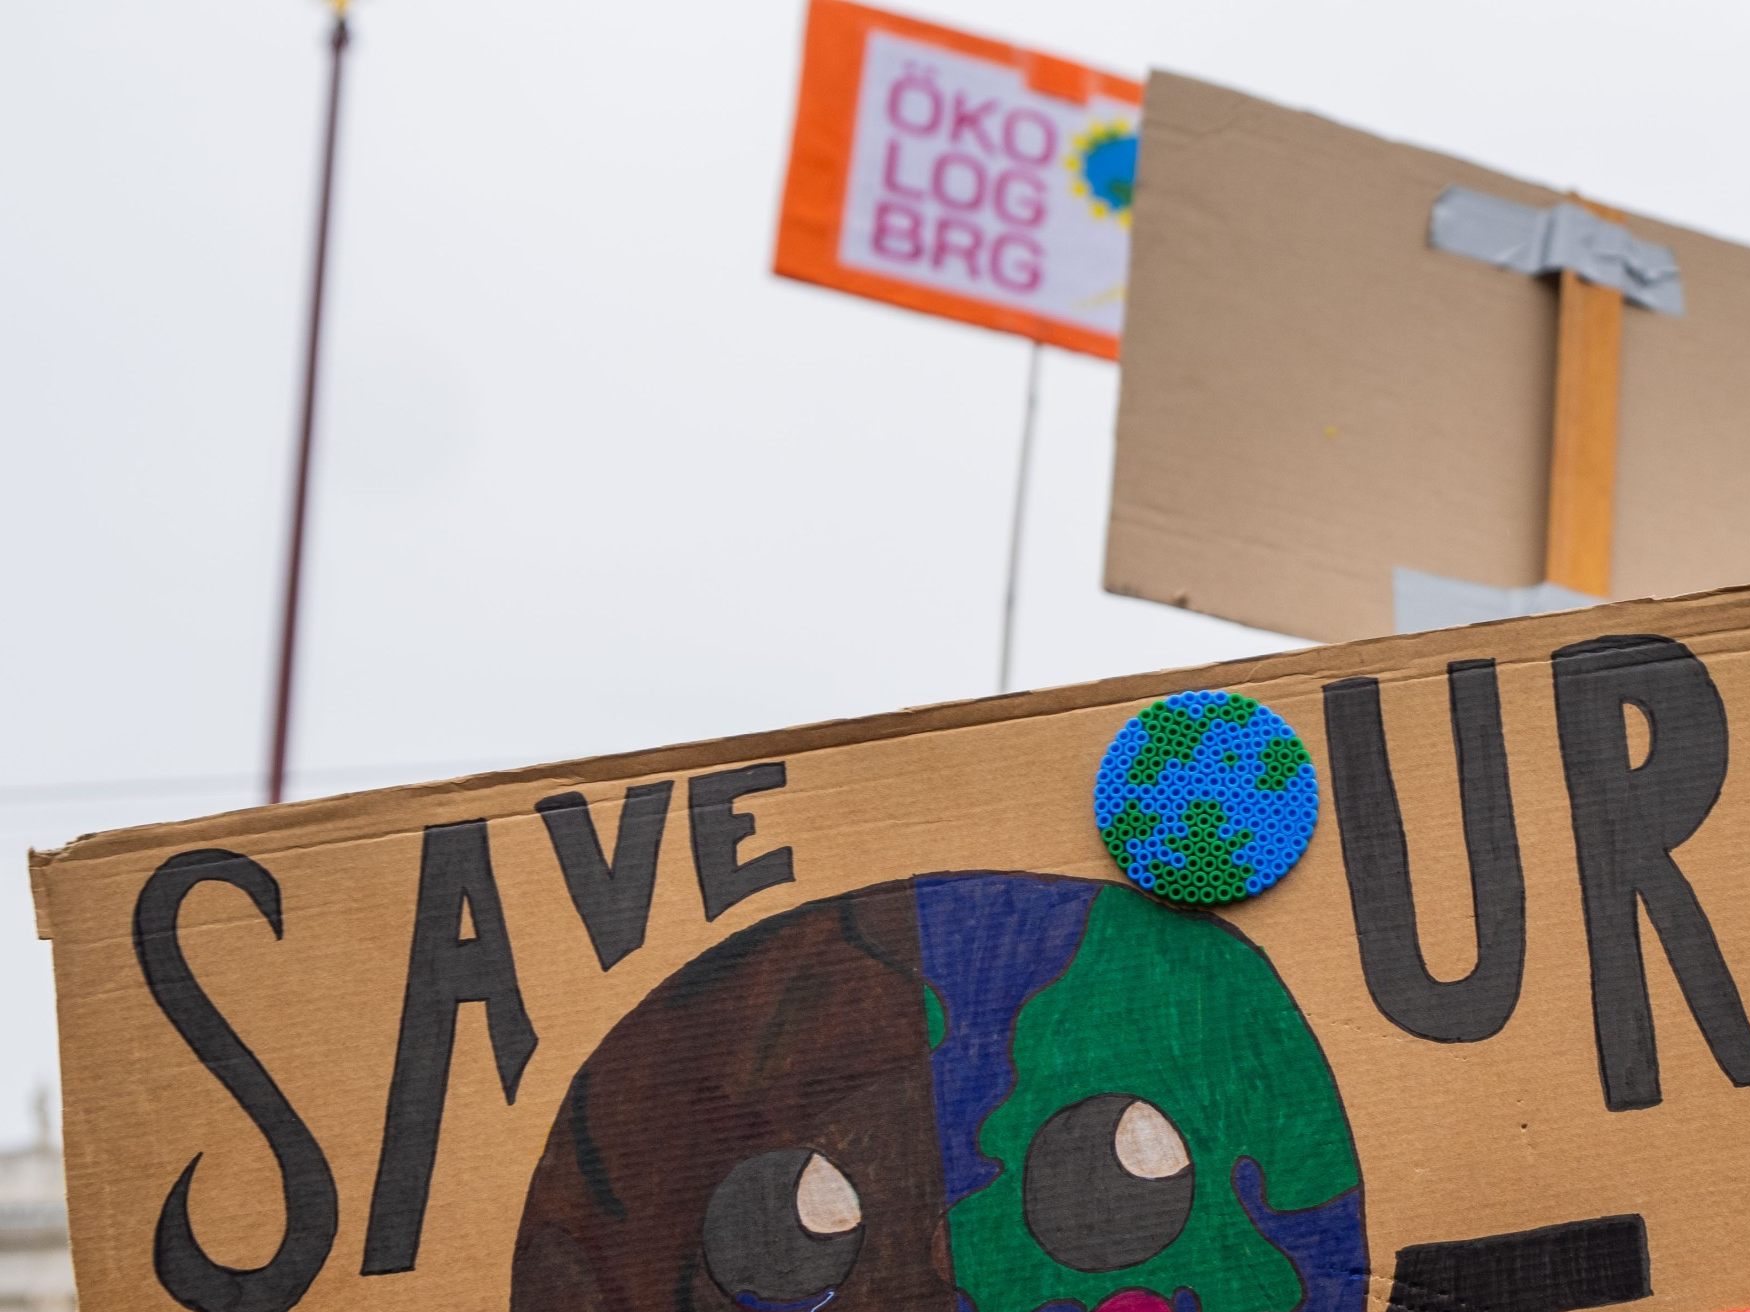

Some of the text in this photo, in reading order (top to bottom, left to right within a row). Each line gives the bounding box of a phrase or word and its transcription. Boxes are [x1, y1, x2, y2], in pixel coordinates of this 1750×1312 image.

[885, 60, 1058, 170] ÖKO
[882, 137, 1047, 229] LOG
[870, 200, 1044, 294] BRG
